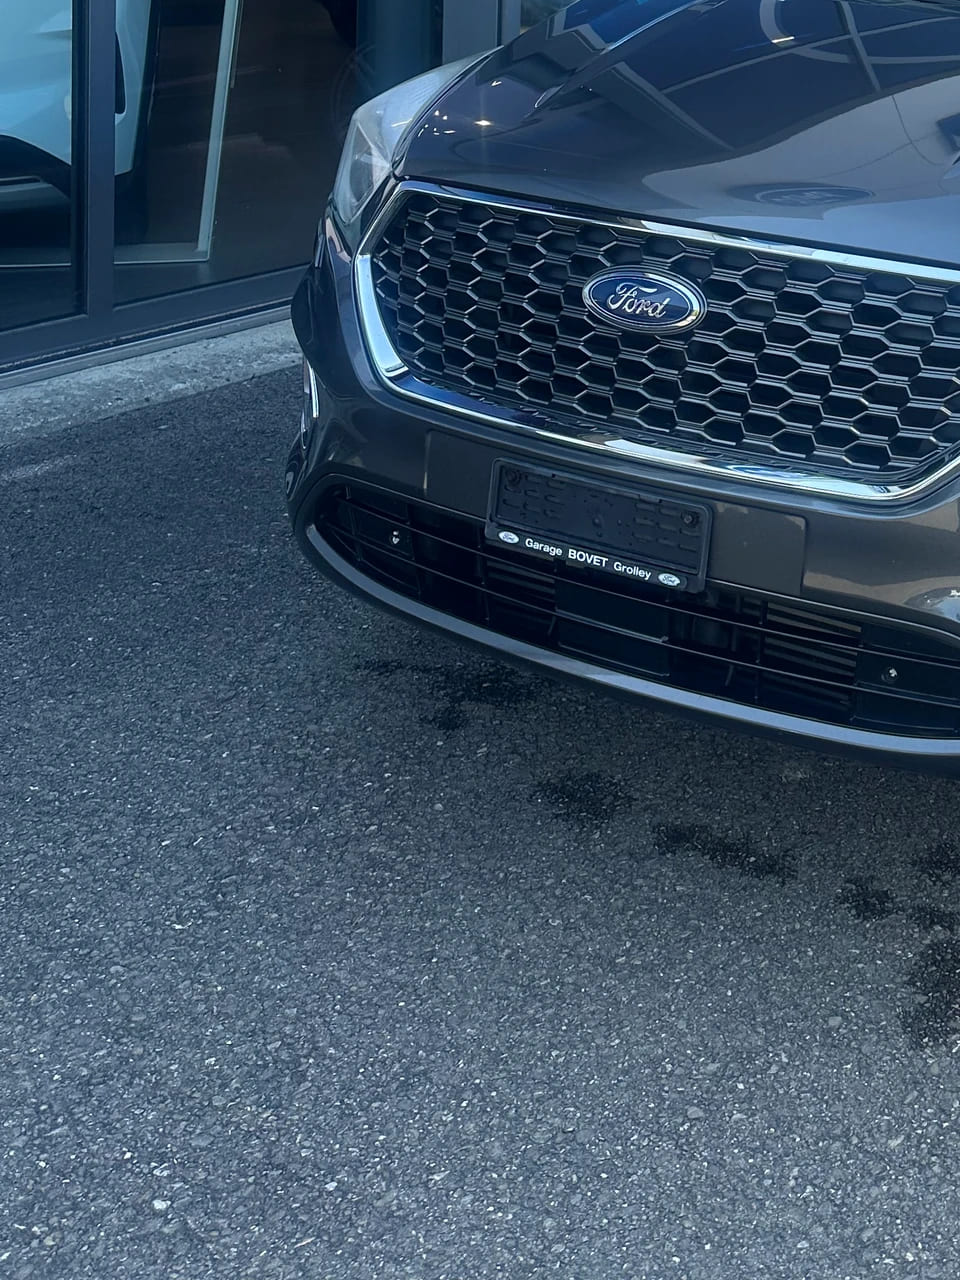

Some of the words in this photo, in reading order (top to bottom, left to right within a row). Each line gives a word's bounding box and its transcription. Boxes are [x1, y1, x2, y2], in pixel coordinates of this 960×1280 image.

[607, 281, 671, 318] Ford
[525, 538, 562, 556] Garage
[568, 548, 608, 567] BOVET
[613, 561, 652, 580] Grolley
